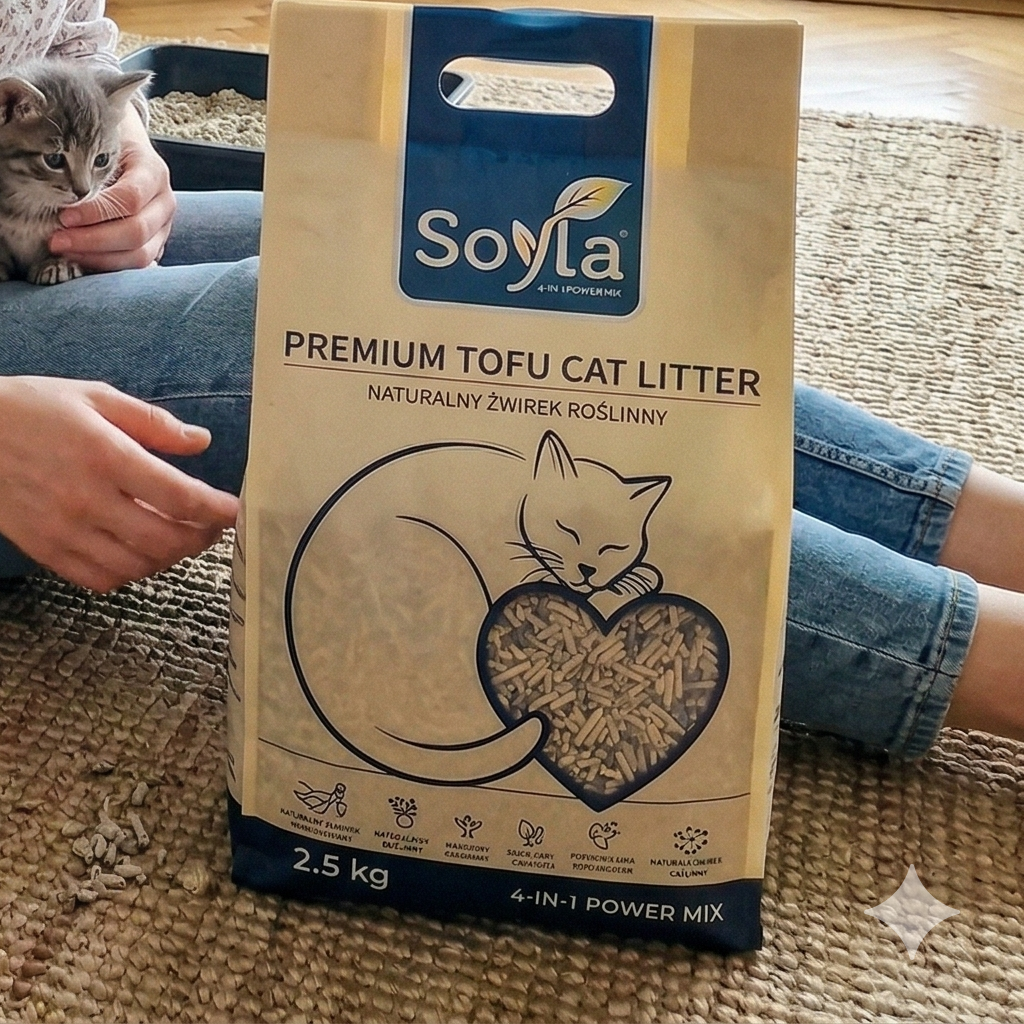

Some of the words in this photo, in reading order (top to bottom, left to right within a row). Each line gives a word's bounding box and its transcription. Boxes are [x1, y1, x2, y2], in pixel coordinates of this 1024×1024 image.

[415, 177, 632, 292] Soyla
[284, 331, 446, 371] PREMIUM
[457, 345, 550, 380] TOFU
[561, 355, 627, 386] CAT
[638, 360, 761, 397] LITTER
[367, 384, 482, 409] NATURALNY
[487, 391, 562, 417] ŻWIREK
[568, 400, 668, 426] ROŚLINNY
[292, 847, 340, 877] 2.5
[351, 857, 389, 890] kg
[510, 887, 577, 910] 4-IN-1
[586, 896, 675, 923] POWER
[683, 903, 724, 923] MIX
